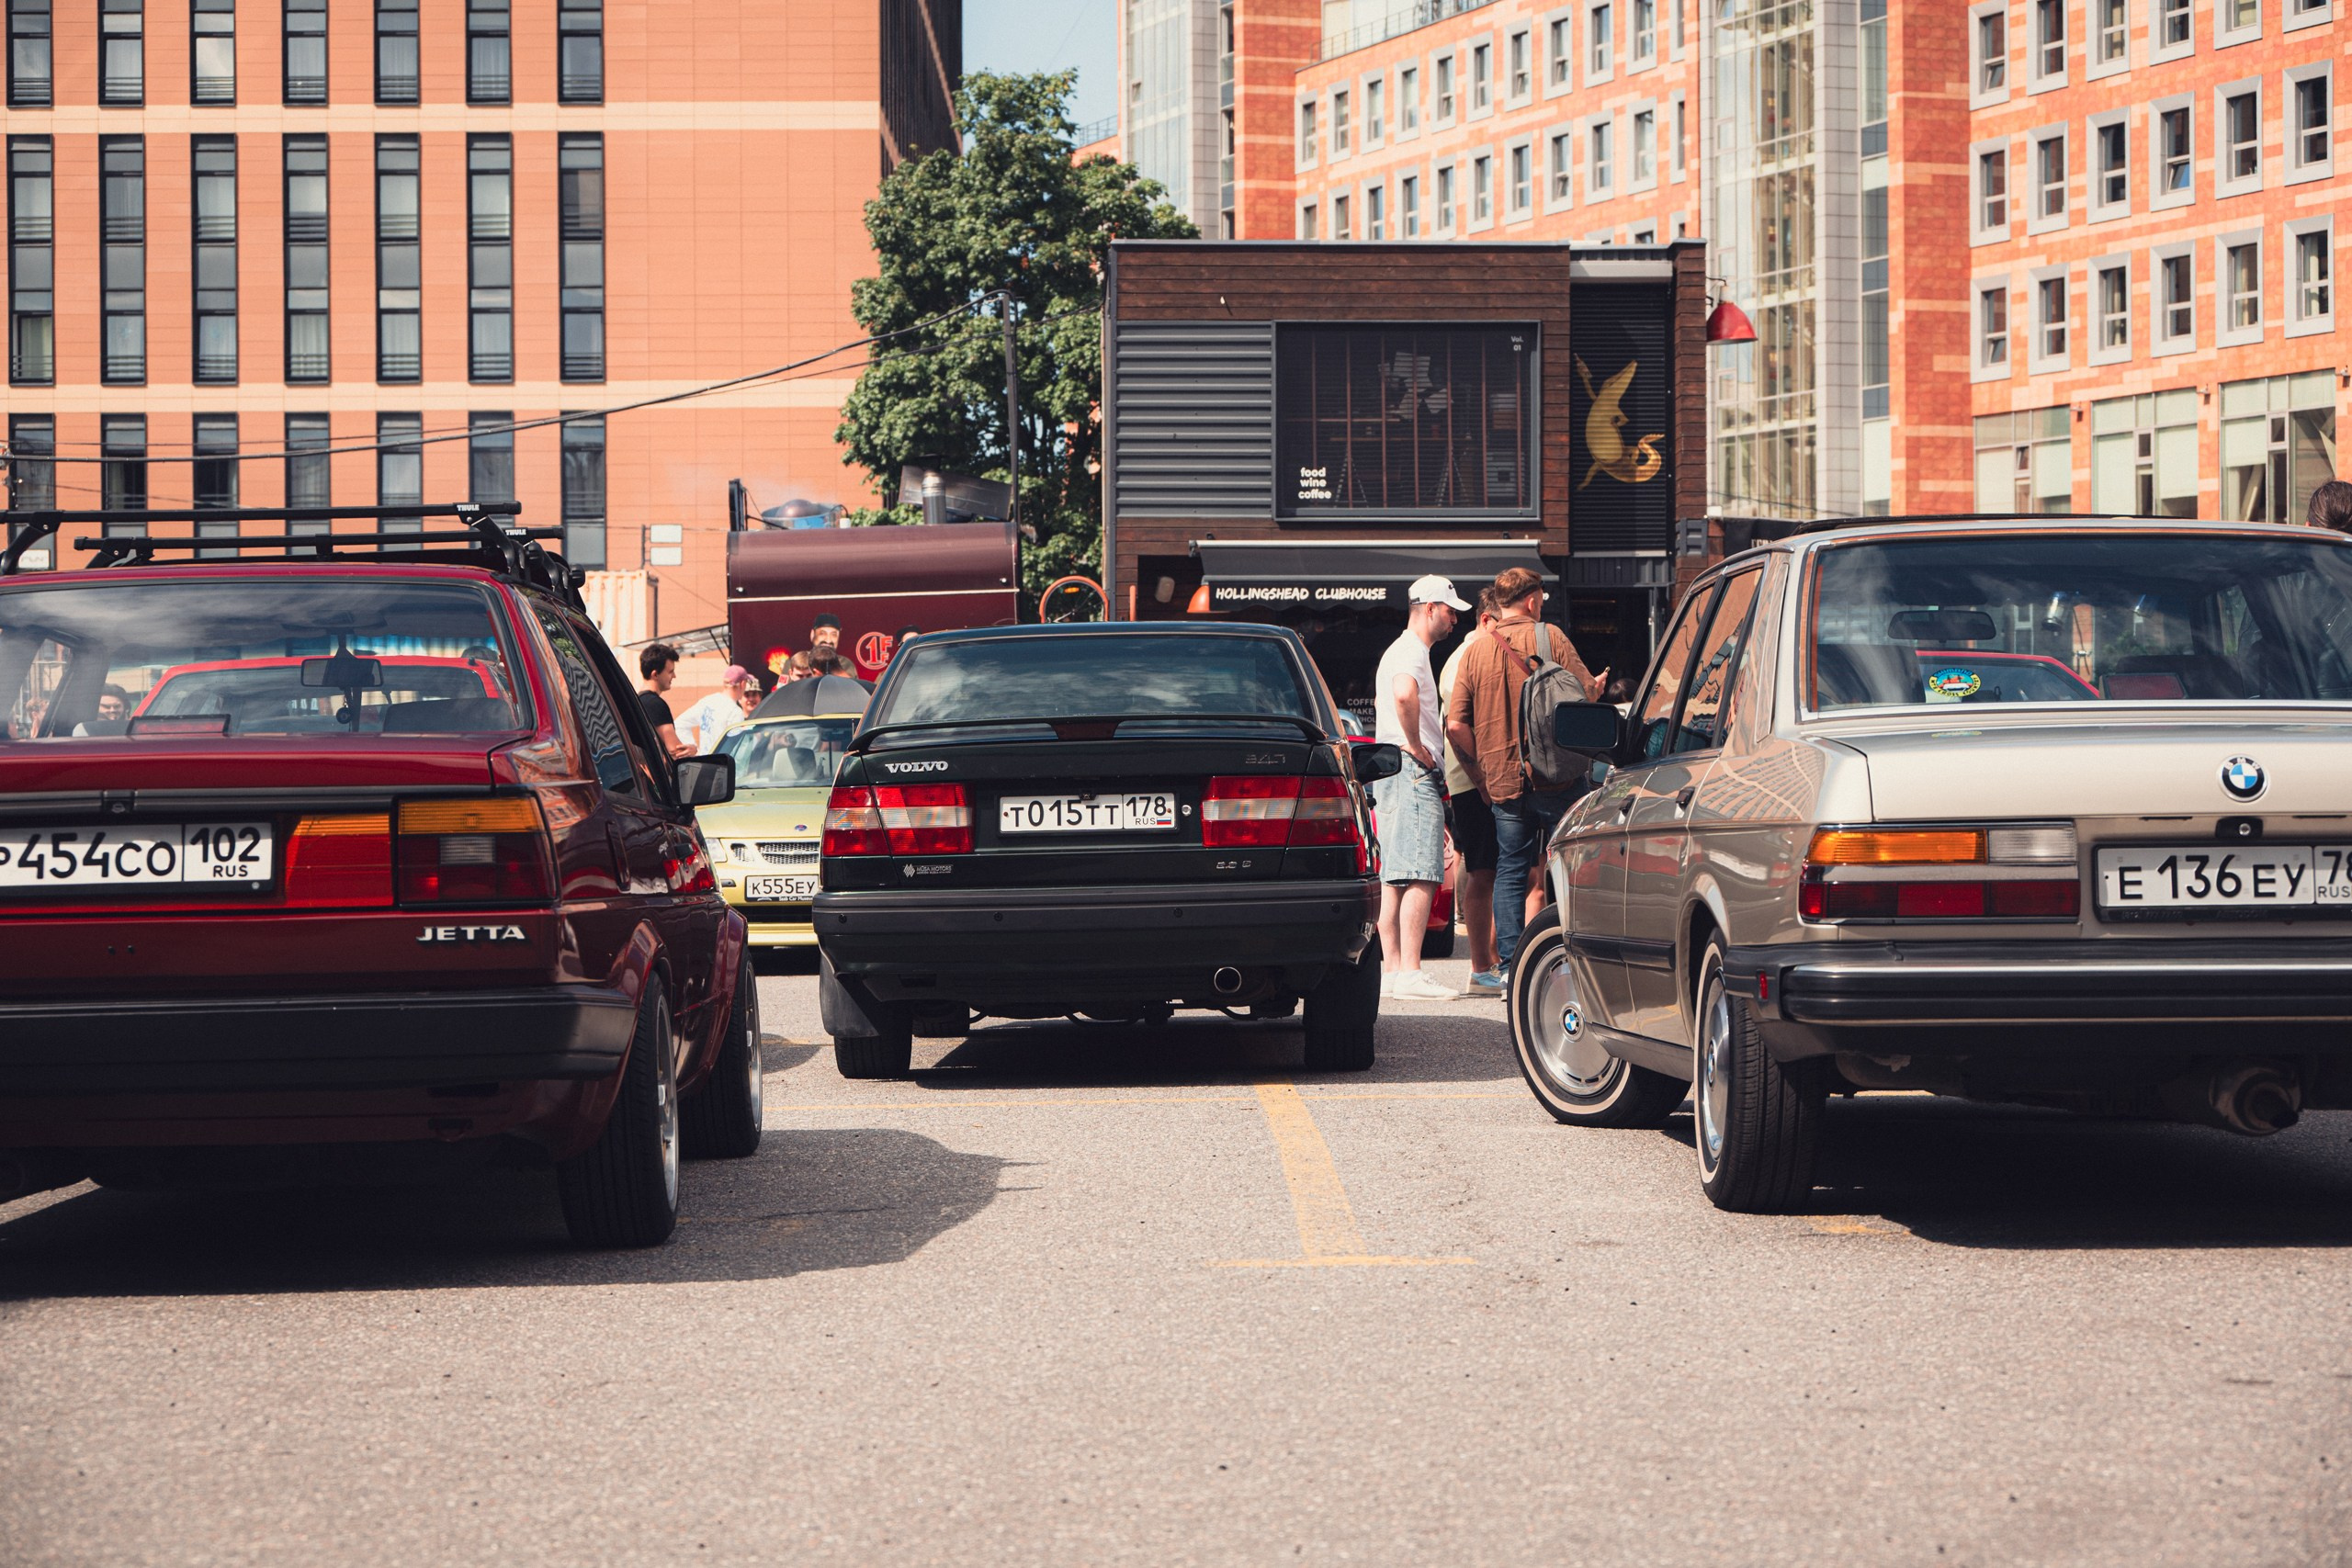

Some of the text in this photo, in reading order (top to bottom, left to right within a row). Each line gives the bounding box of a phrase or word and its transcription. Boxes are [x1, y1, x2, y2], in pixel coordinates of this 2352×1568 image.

[1300, 467, 1326, 477] food
[1300, 477, 1327, 487] wine
[1298, 489, 1332, 499] coffee
[1216, 587, 1386, 601] HOLLINGSHEAD CLUBHOUSE
[885, 761, 949, 773] VOLVO
[1125, 796, 1166, 817] 178
[189, 827, 261, 863] 102
[213, 864, 248, 877] RUS
[2318, 886, 2351, 897] RUS
[416, 925, 526, 941] JETTA
